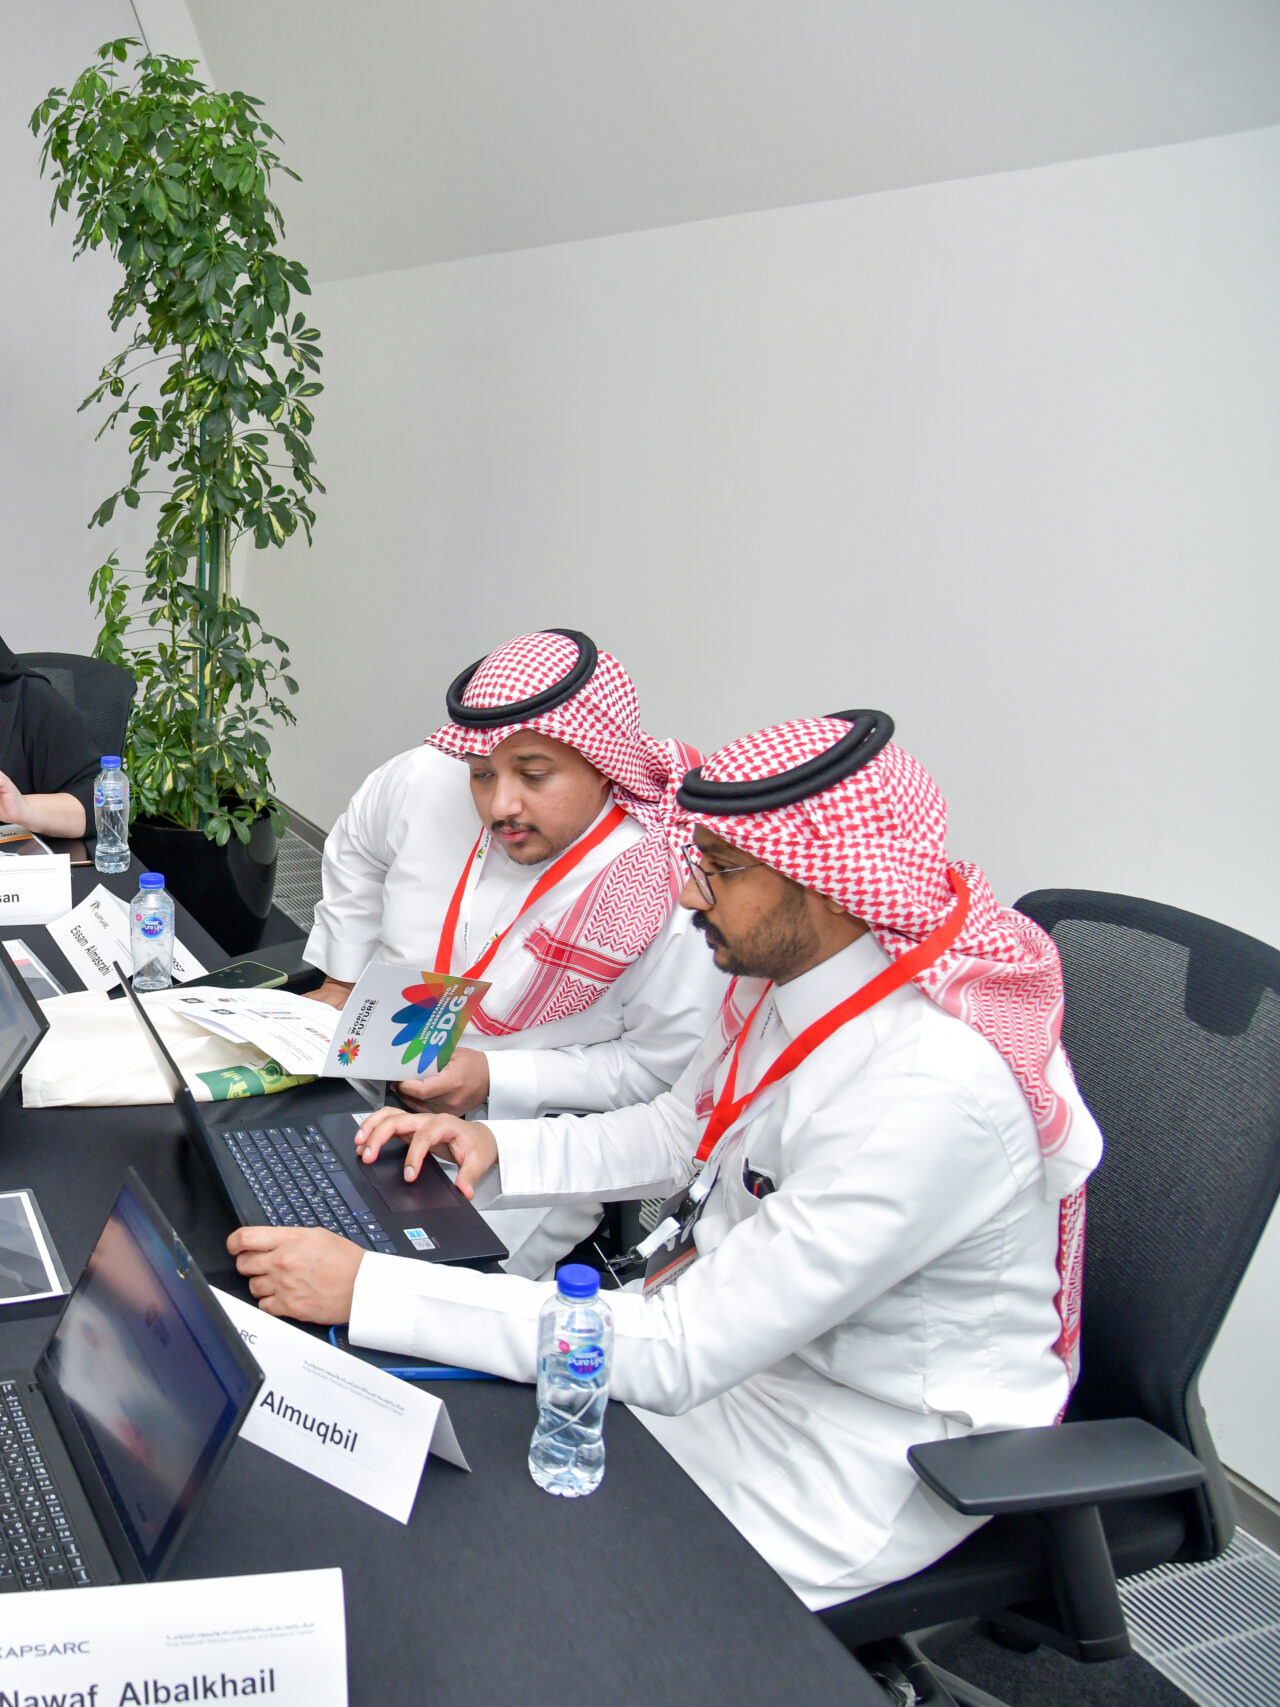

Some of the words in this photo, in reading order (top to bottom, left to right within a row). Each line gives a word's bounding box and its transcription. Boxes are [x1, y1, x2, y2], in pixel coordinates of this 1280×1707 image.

[70, 924, 88, 947] Essam
[85, 944, 114, 977] Almasrahi
[350, 999, 370, 1034] WORLD'S
[355, 1000, 377, 1035] FUTURE
[419, 987, 451, 1040] UNDERSTANDING
[430, 986, 475, 1046] SDGs
[423, 1030, 431, 1044] AND
[260, 1390, 358, 1453] Almuqbil
[119, 1668, 277, 1707] Albalkhail
